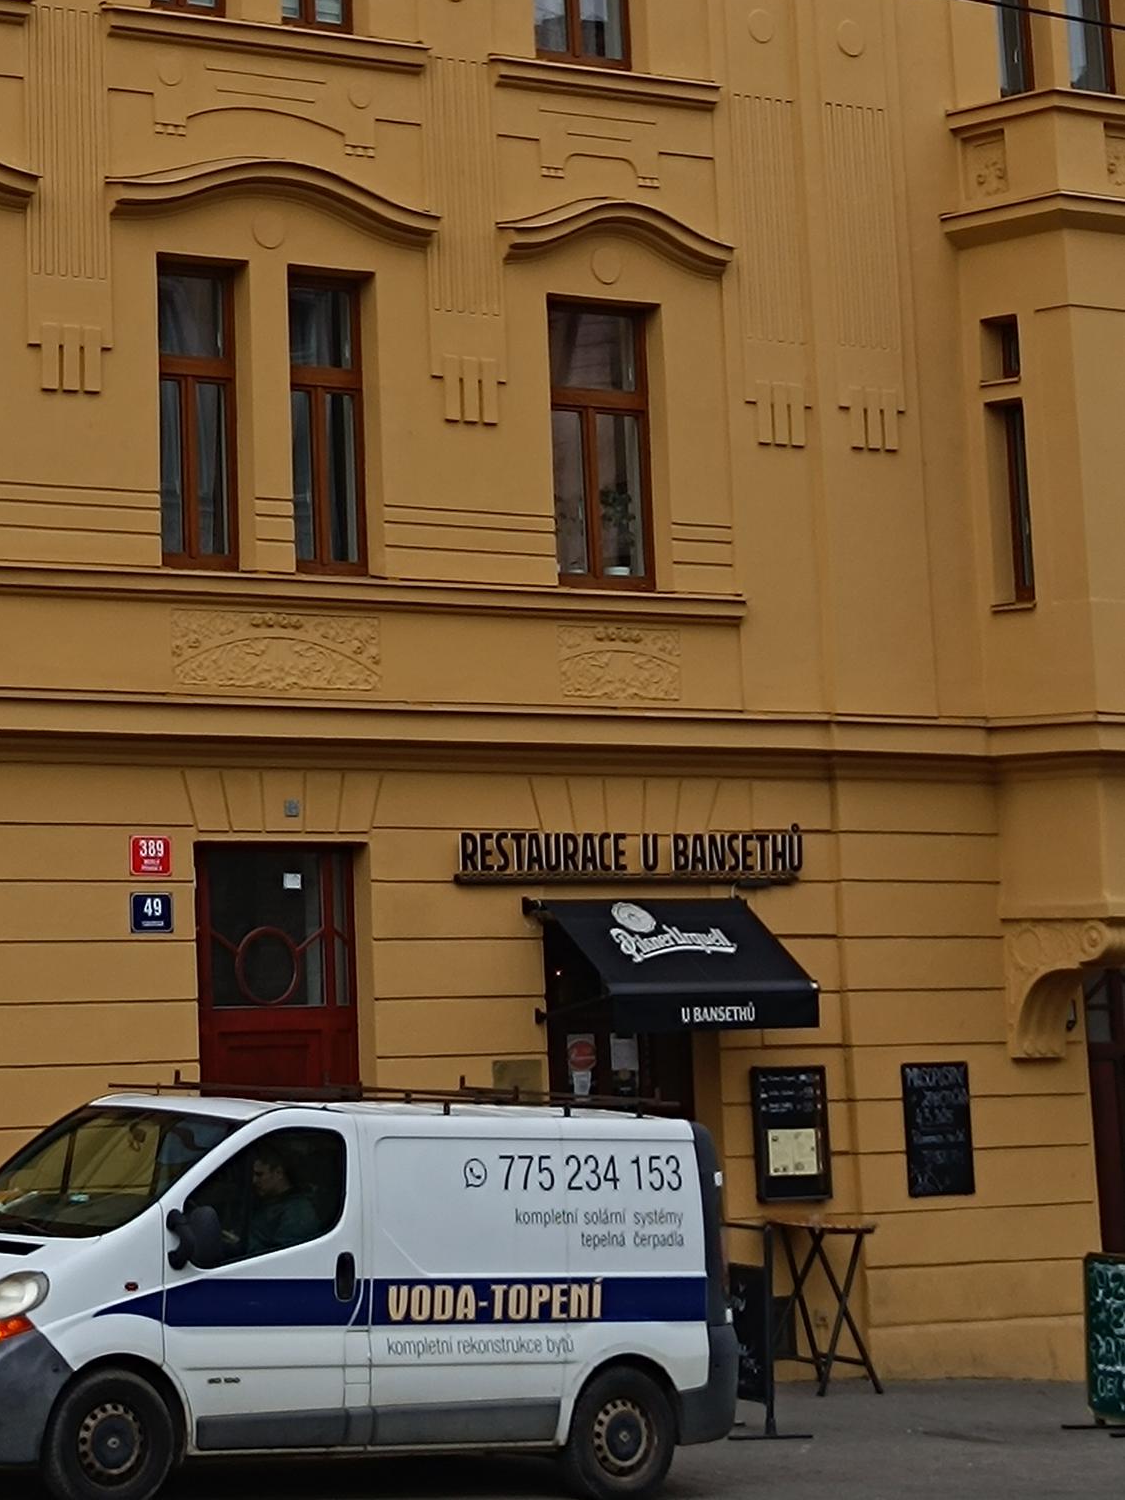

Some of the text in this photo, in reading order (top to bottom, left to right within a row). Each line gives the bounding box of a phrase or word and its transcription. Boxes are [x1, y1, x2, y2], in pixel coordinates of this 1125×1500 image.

[139, 840, 164, 857] 389
[459, 822, 803, 872] RESTAURACE U BANSETHŮ
[143, 897, 162, 916] 49
[681, 1001, 755, 1022] U BANSETHŮ
[499, 1154, 683, 1191] 775 234 153
[515, 1208, 684, 1228] kompletní solární systémy
[581, 1230, 684, 1249] tepelná čerpadla
[386, 1333, 574, 1358] kompletní rekonstrukce bytů
